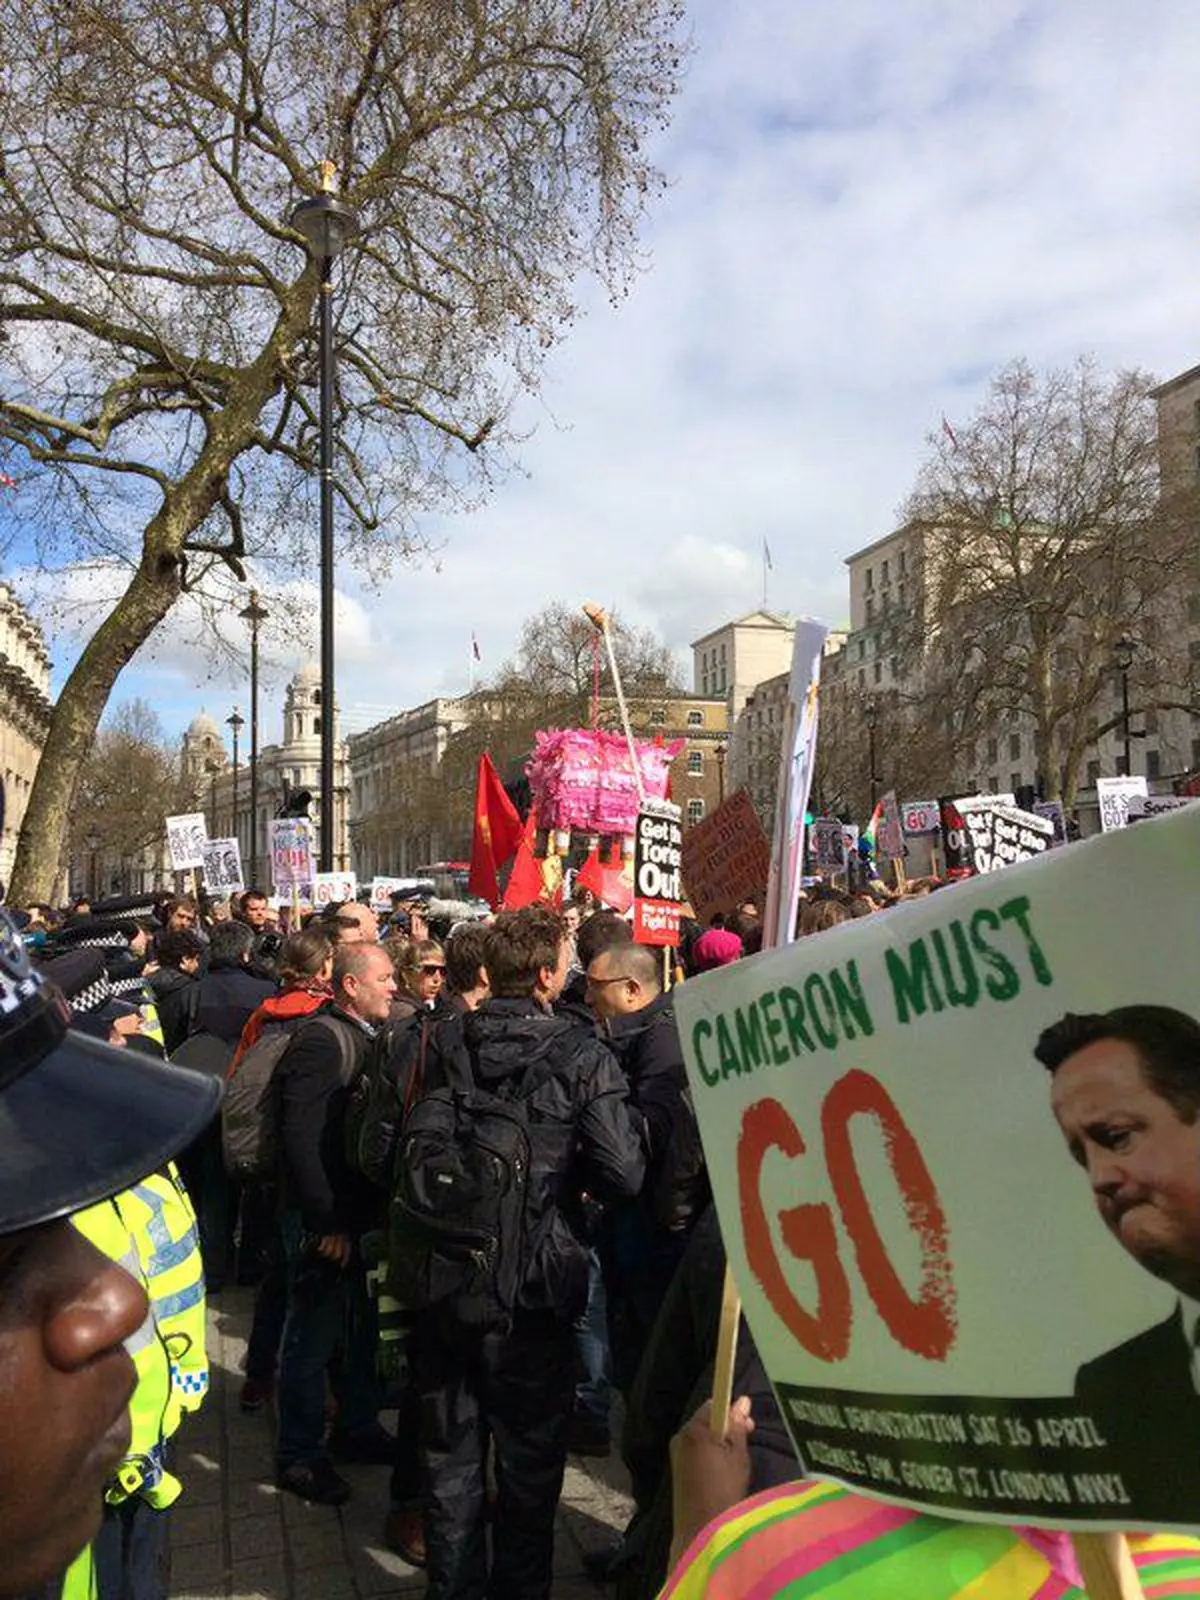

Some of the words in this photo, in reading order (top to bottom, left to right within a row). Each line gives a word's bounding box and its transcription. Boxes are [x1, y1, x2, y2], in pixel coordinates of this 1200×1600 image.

[640, 818, 669, 841] Get
[670, 823, 681, 844] th
[995, 818, 1018, 841] Get
[640, 838, 681, 867] Torie
[317, 884, 335, 901] GO
[639, 862, 681, 900] Out
[692, 959, 874, 1087] CAMERON
[884, 896, 1052, 1024] MUST
[737, 1068, 957, 1363] GO
[969, 1413, 1001, 1446] SAT
[1003, 1417, 1033, 1447] 16
[1036, 1417, 1107, 1448] APRIL
[989, 1469, 1071, 1503] LONDON
